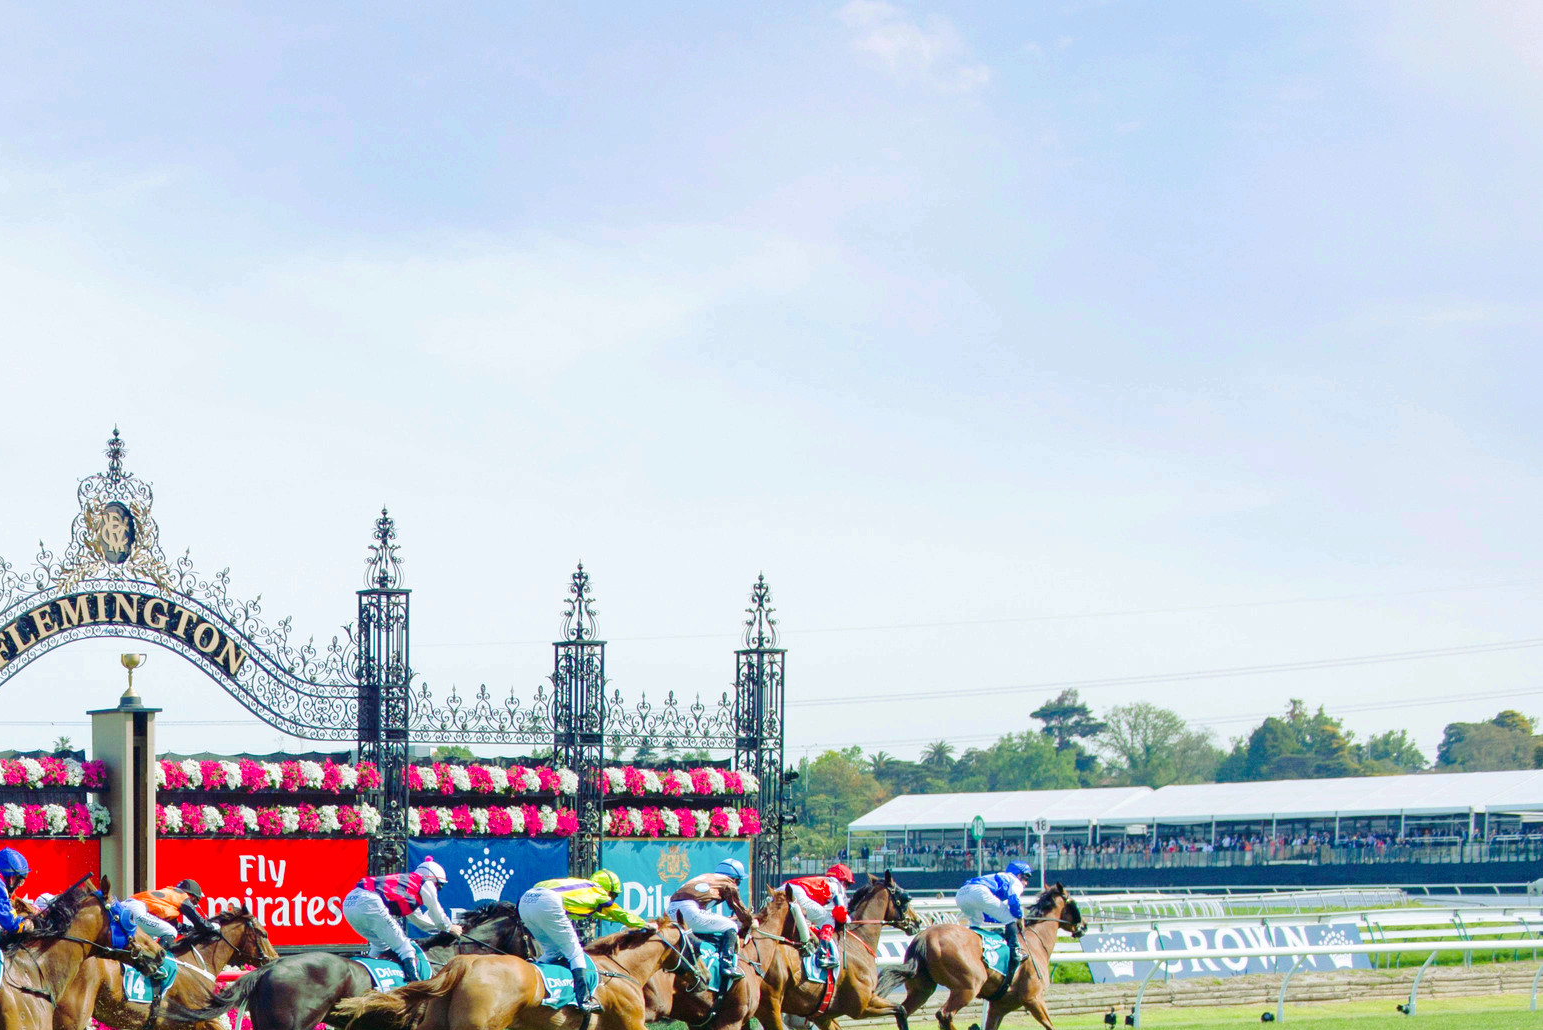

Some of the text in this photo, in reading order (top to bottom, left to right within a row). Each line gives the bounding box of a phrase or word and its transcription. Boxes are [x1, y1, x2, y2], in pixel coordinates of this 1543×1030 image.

[972, 819, 984, 836] 18
[1035, 820, 1046, 831] 18
[239, 855, 286, 887] Fly
[183, 887, 343, 927] mirates
[1146, 925, 1317, 974] CROWN
[126, 970, 146, 1000] 14
